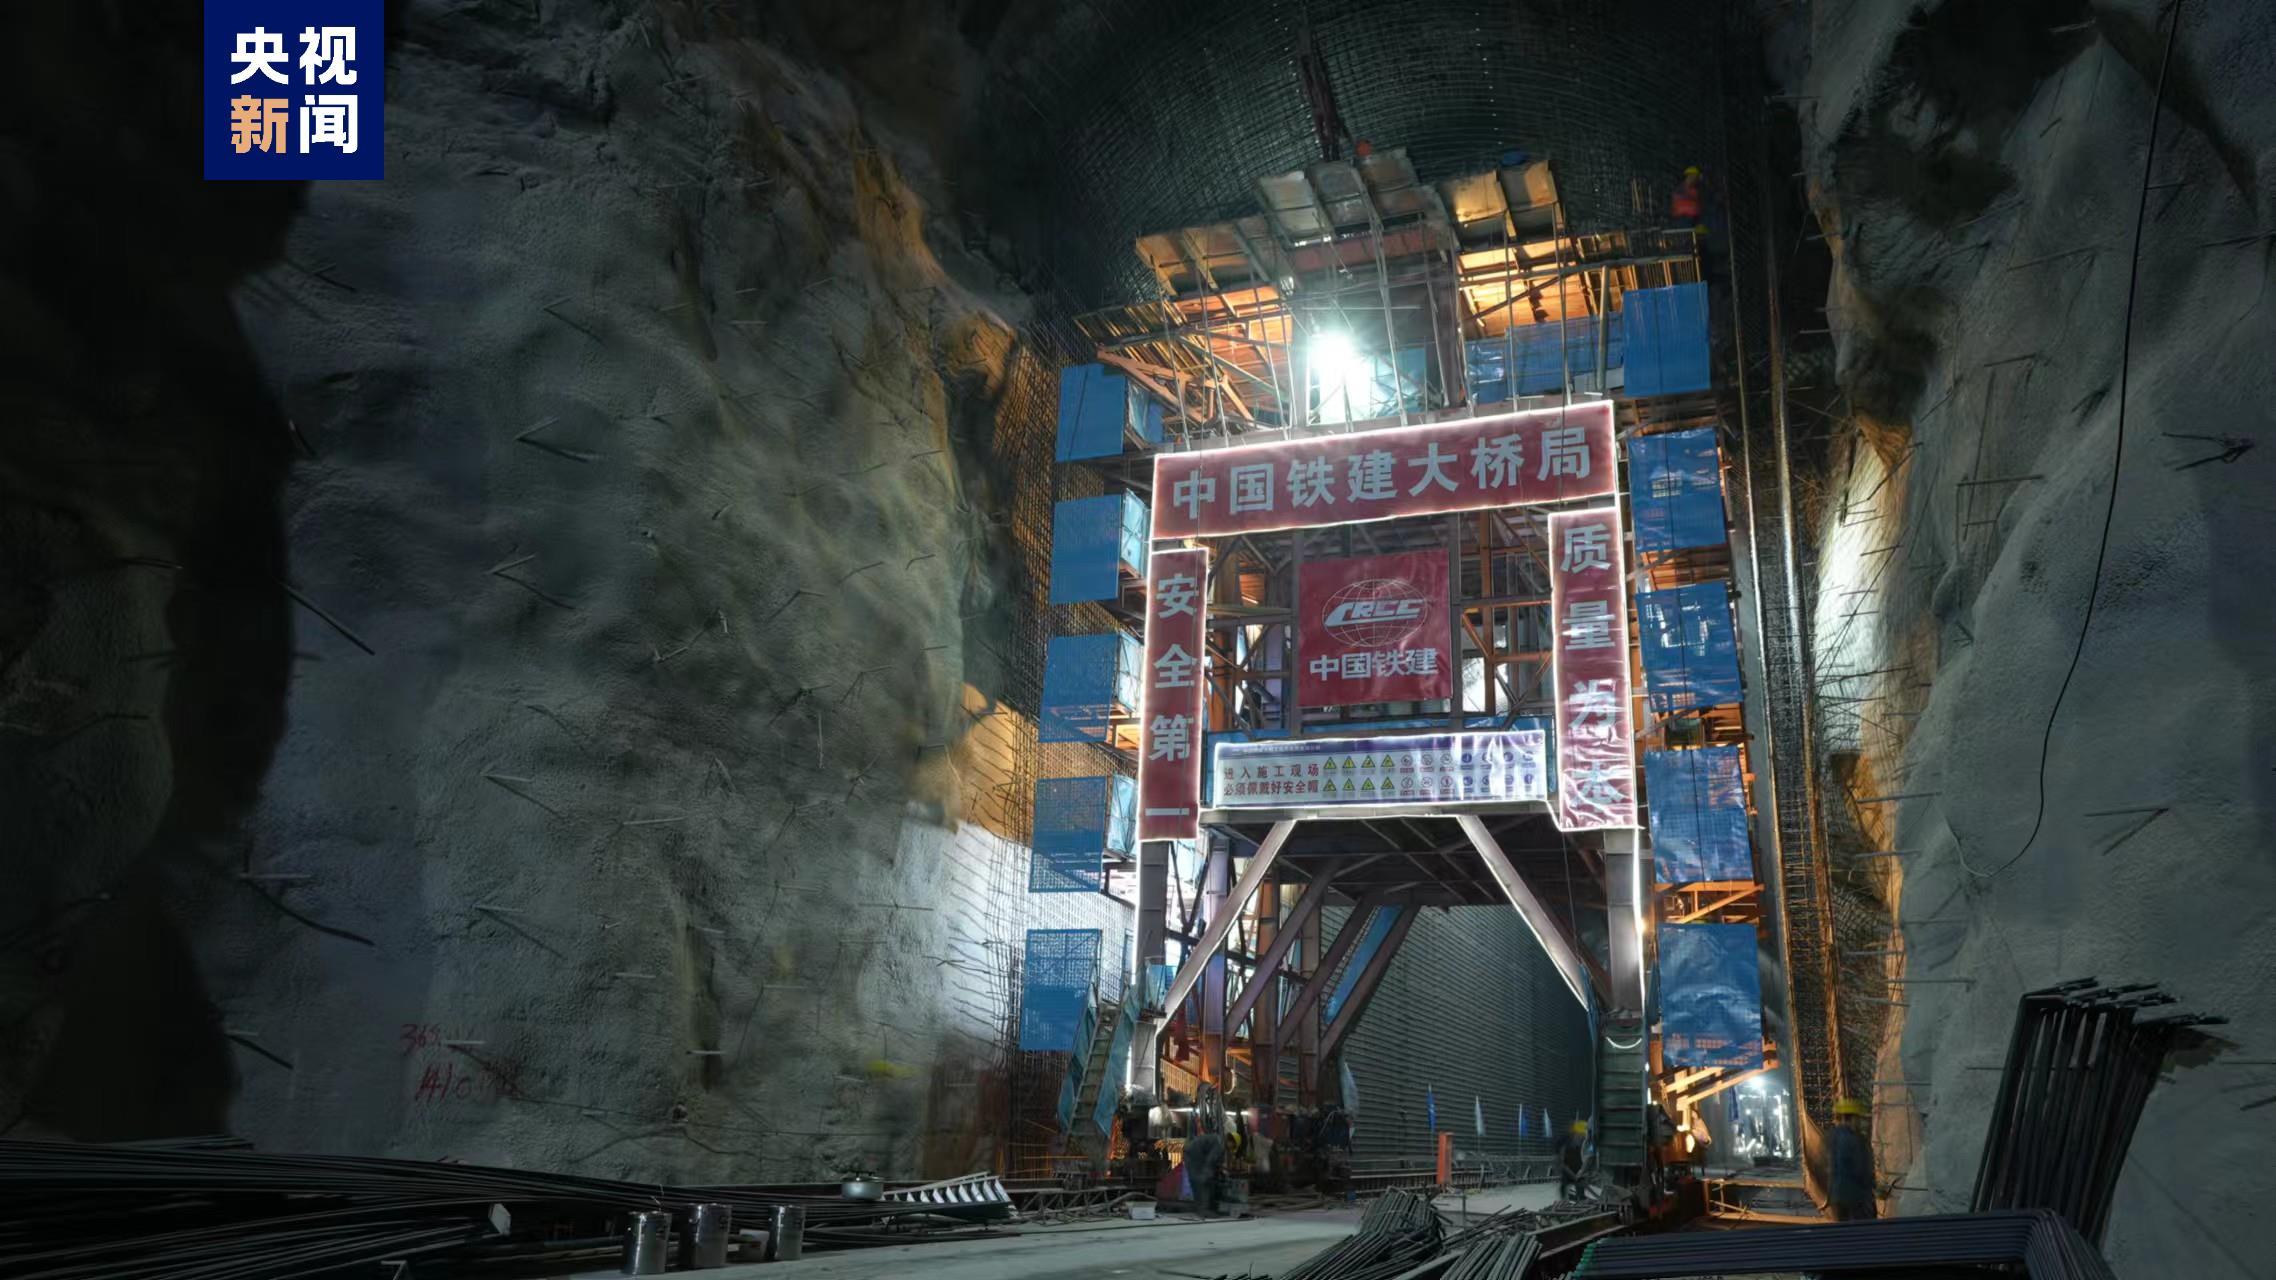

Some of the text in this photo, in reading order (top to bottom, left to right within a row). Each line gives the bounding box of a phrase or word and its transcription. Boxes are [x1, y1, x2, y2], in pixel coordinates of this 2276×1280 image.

[1173, 426, 1591, 520] 中国铁建大桥局
[1324, 599, 1425, 627] CRCC
[1309, 648, 1439, 681] 中国铁建
[1145, 573, 1198, 816] 安全第一
[1223, 763, 1319, 780] 进入施工现场
